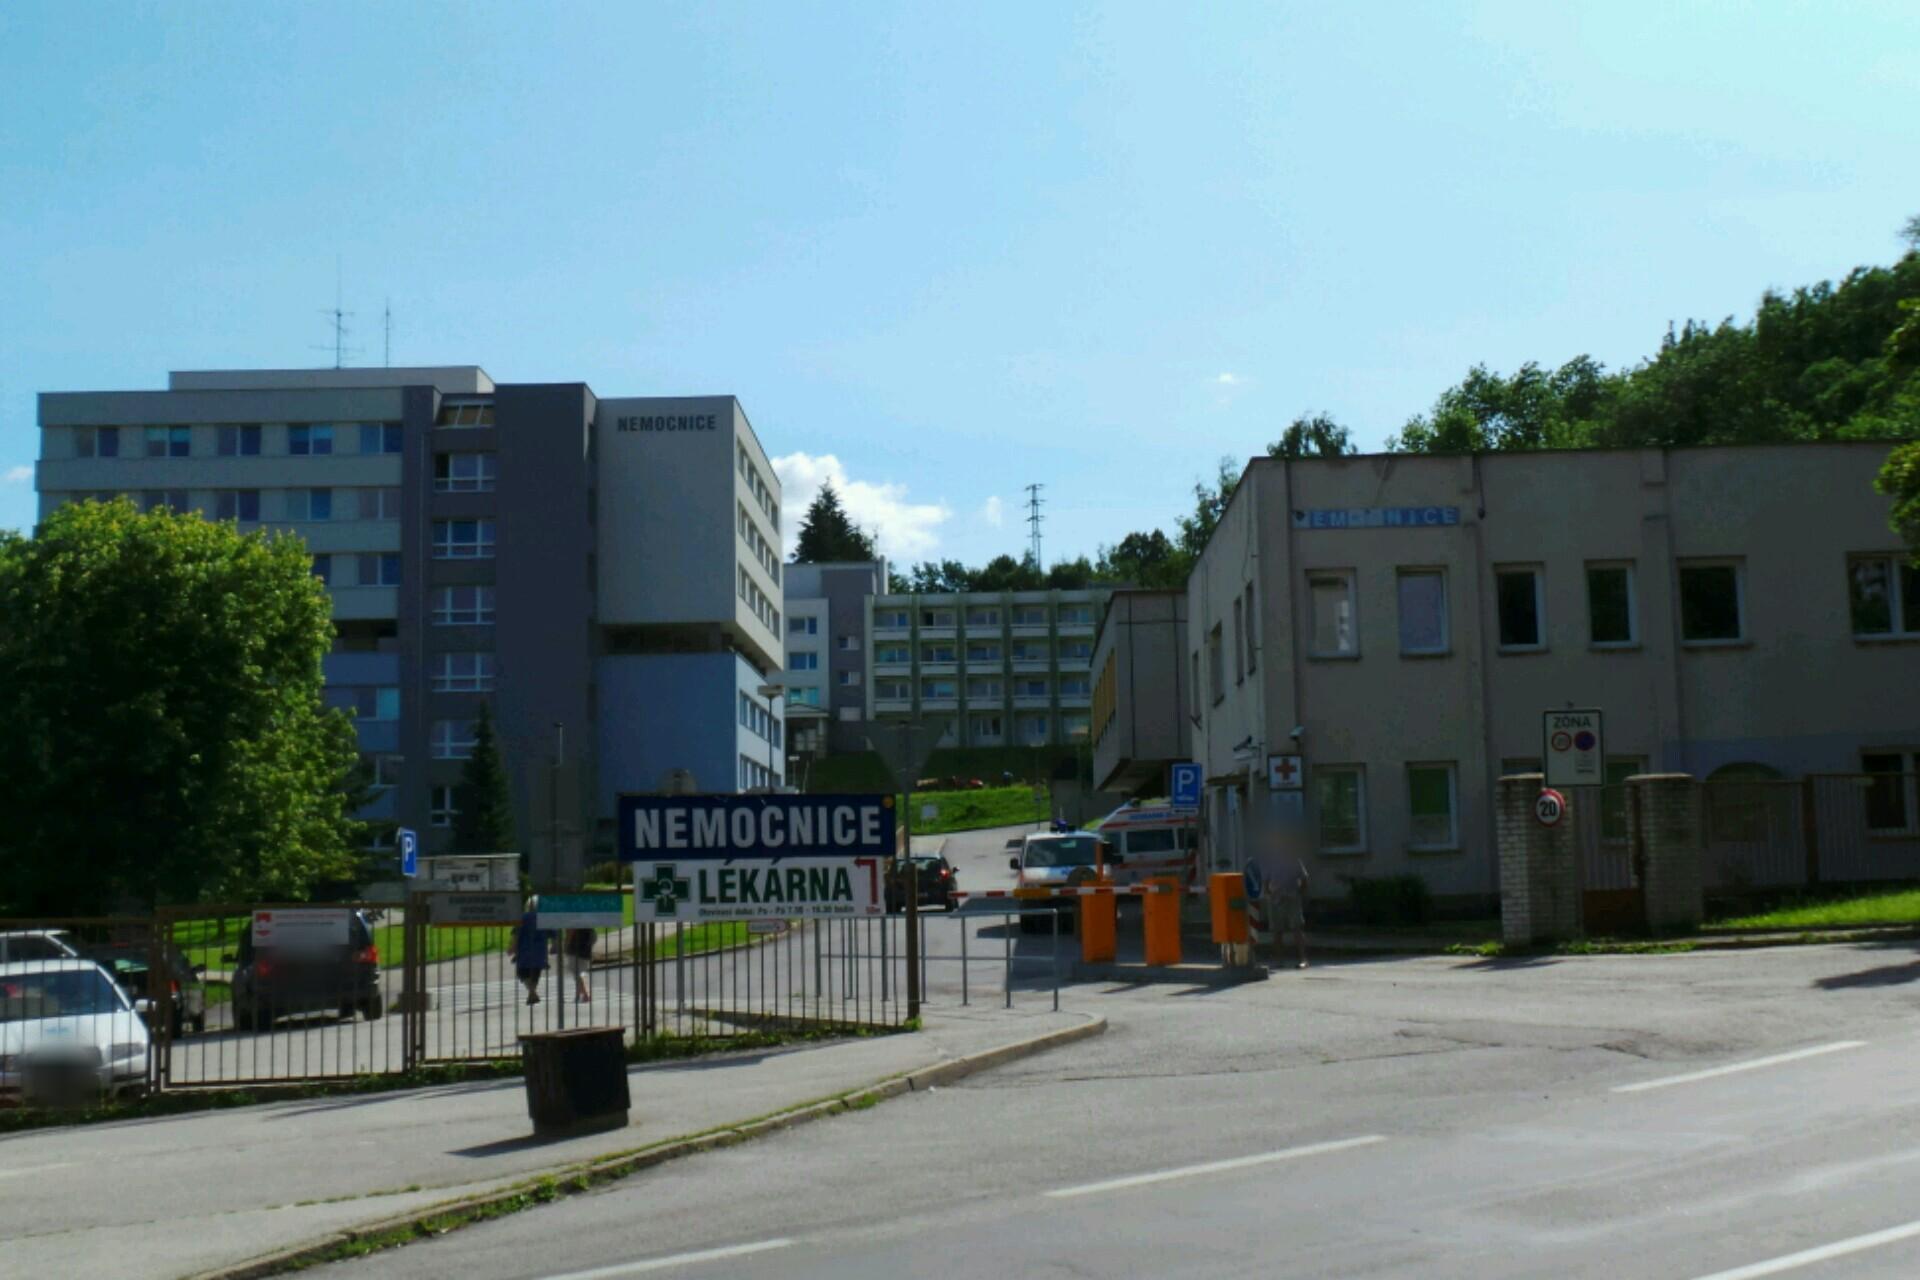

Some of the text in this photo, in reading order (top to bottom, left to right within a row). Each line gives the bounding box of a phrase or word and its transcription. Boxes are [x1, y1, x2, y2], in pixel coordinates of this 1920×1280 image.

[617, 415, 717, 432] NEMOCNICE
[1295, 508, 1458, 528] EMNICE
[1552, 716, 1592, 728] ZONA
[1177, 769, 1195, 793] P
[1539, 802, 1557, 817] 20
[635, 805, 882, 848] NEMOCNICE
[405, 836, 414, 861] P
[699, 858, 853, 904] LÉKÁRNA
